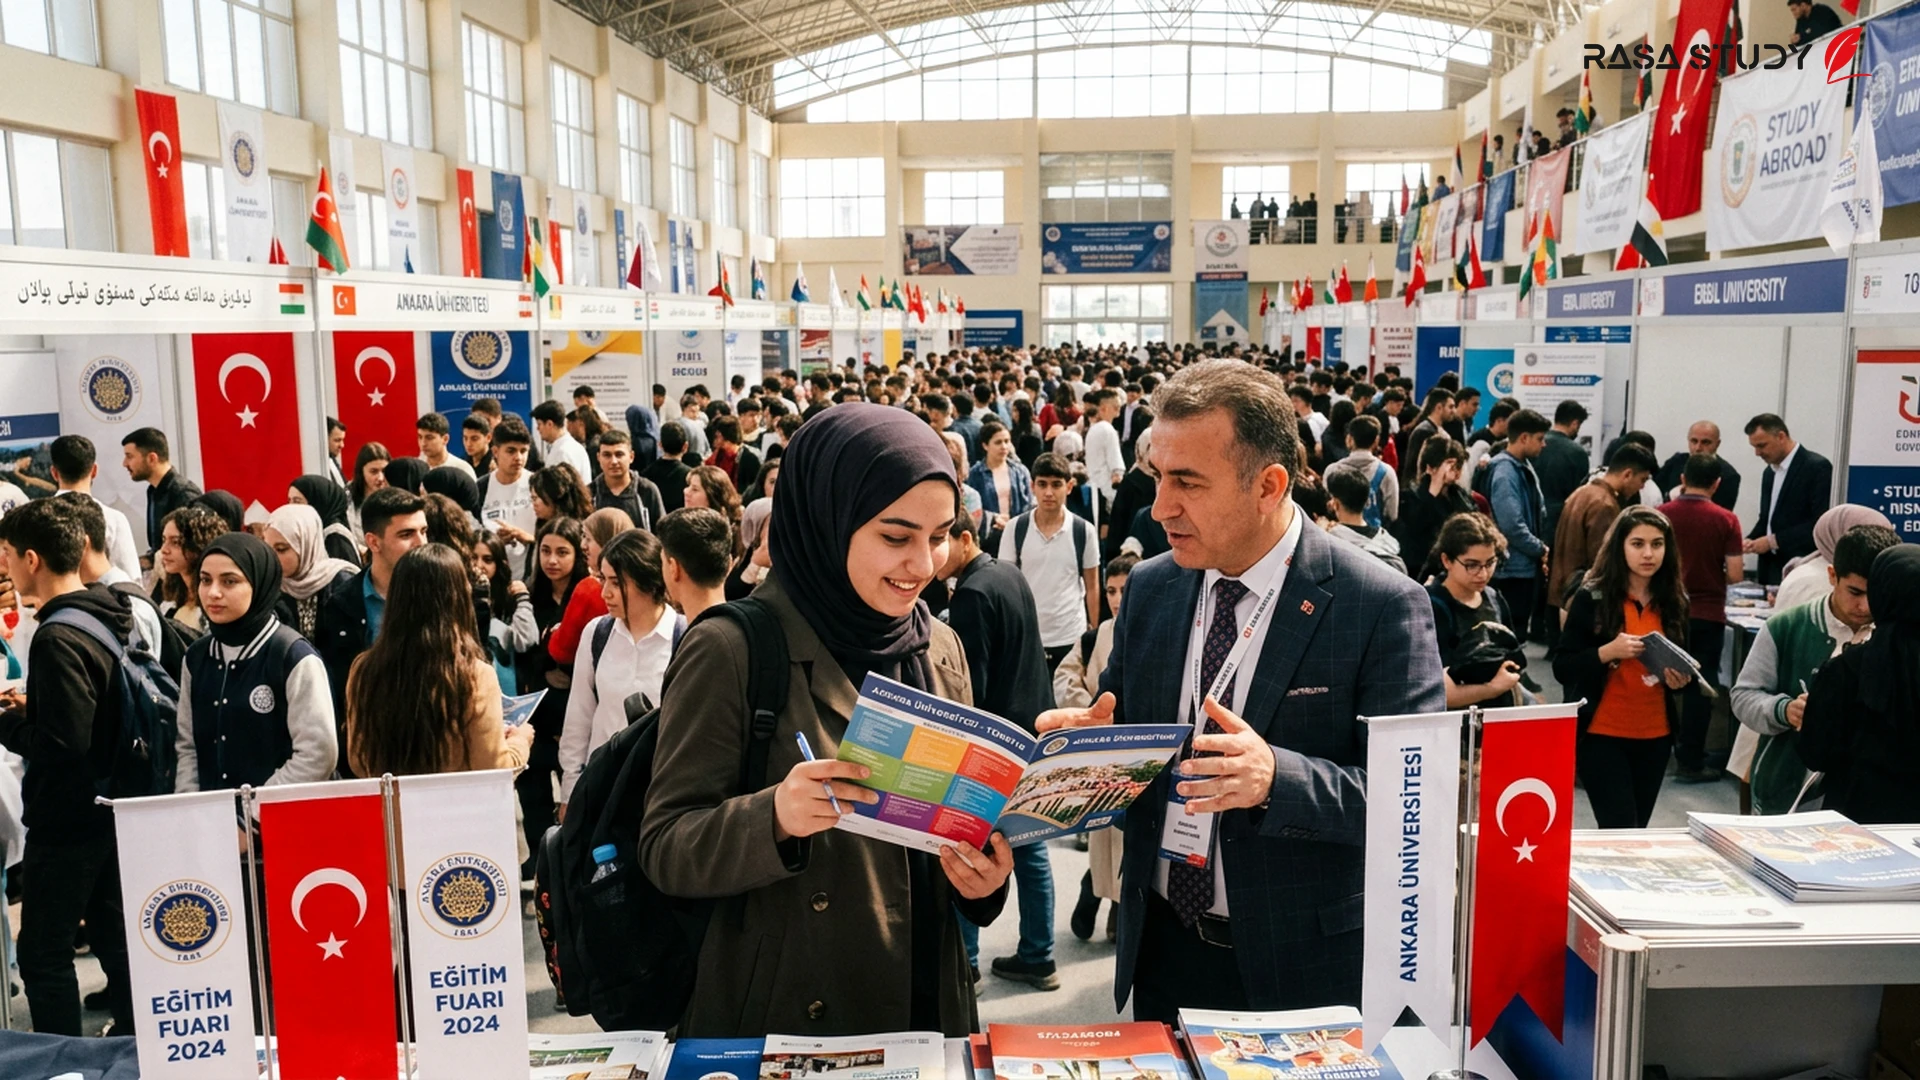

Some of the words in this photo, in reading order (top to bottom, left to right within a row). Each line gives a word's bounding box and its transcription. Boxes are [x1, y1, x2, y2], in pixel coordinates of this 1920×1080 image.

[1766, 99, 1822, 143] STUDY
[1398, 746, 1422, 888] ÜNİVERSİTESİ
[1399, 894, 1418, 983] ANKARA
[429, 963, 507, 989] EĞİTİM
[151, 986, 233, 1015] EĞİTİM
[435, 989, 504, 1011] FUARI
[158, 1013, 230, 1039] FUARI
[443, 1014, 500, 1036] 2024
[168, 1039, 226, 1062] 2024
